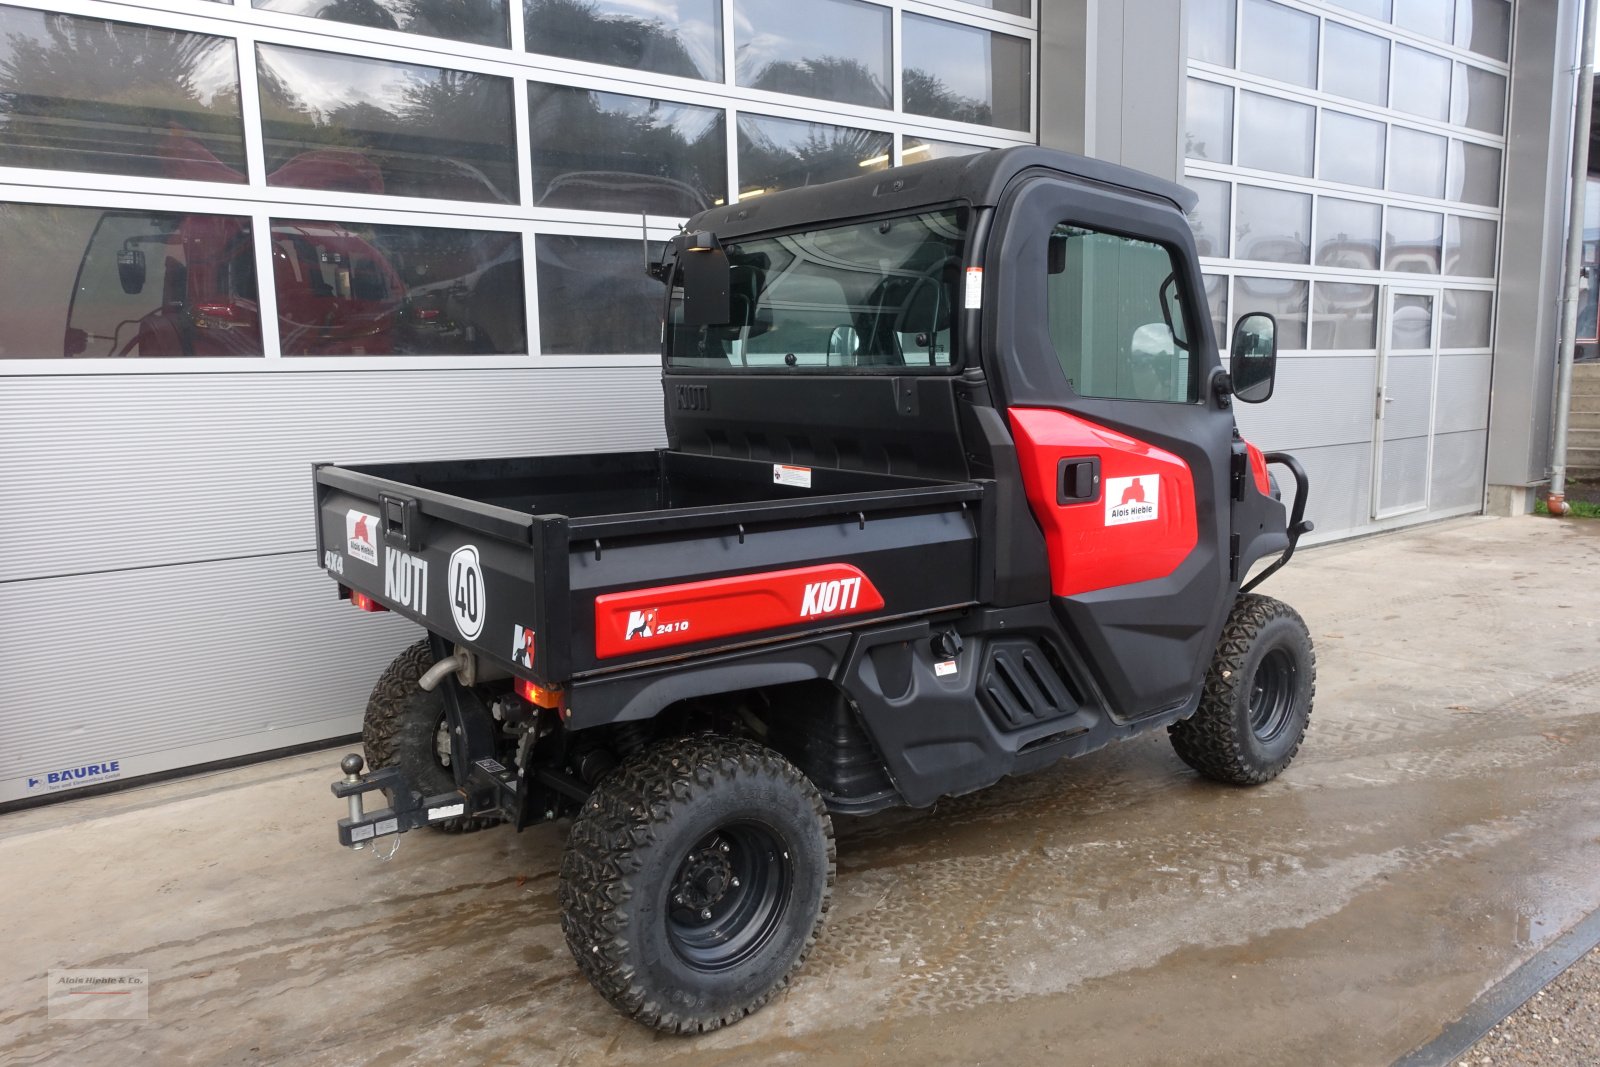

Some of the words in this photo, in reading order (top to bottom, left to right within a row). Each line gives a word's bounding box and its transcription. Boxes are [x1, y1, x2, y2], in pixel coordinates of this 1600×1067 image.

[1112, 509, 1129, 518] Alois
[1131, 505, 1153, 515] Hieble
[384, 546, 428, 617] KIOTI
[455, 562, 478, 623] 40
[800, 576, 862, 617] KIOTI
[656, 621, 689, 635] 2410
[47, 761, 119, 783] BÄURLE
